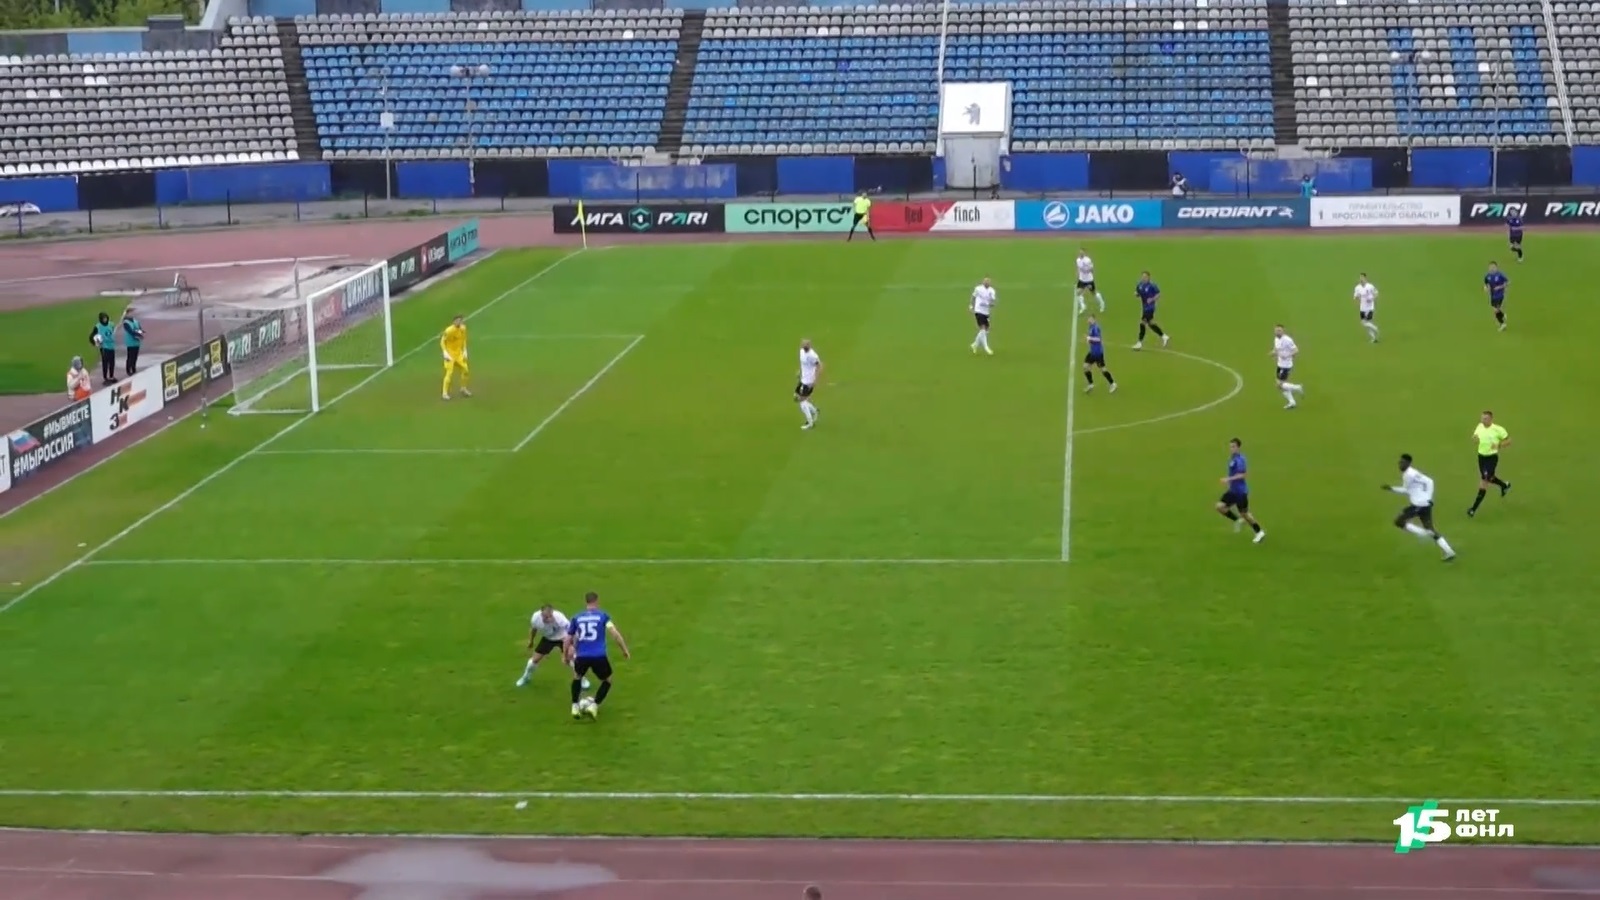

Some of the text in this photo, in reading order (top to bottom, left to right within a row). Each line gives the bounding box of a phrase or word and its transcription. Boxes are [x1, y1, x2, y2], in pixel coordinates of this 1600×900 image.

[657, 211, 708, 225] PARI
[953, 205, 981, 222] finch
[1075, 204, 1134, 224] JAKO
[1177, 206, 1278, 219] CORDIANT
[43, 404, 91, 439] #МЫВМЕСТЕ
[13, 432, 74, 478] #МЫРОССИЯ
